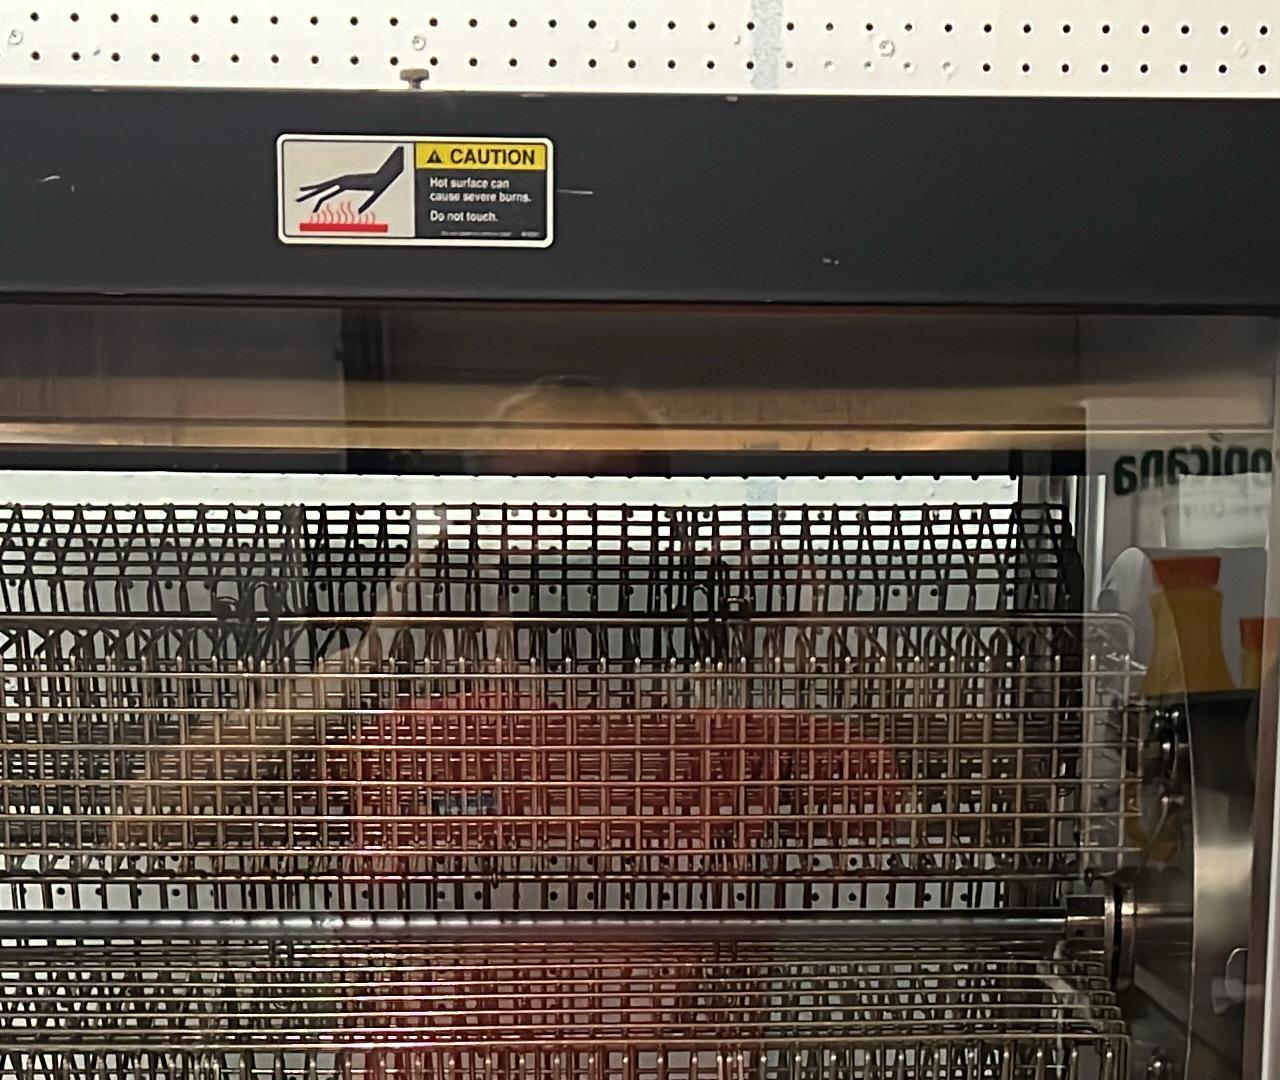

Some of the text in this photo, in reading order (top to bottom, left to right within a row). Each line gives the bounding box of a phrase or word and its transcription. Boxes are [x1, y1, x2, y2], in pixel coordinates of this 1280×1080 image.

[450, 148, 535, 166] CAUTION
[429, 177, 510, 189] Hot surface can
[429, 192, 461, 202] cause
[463, 192, 497, 202] severe
[430, 210, 499, 222] Do not touch.
